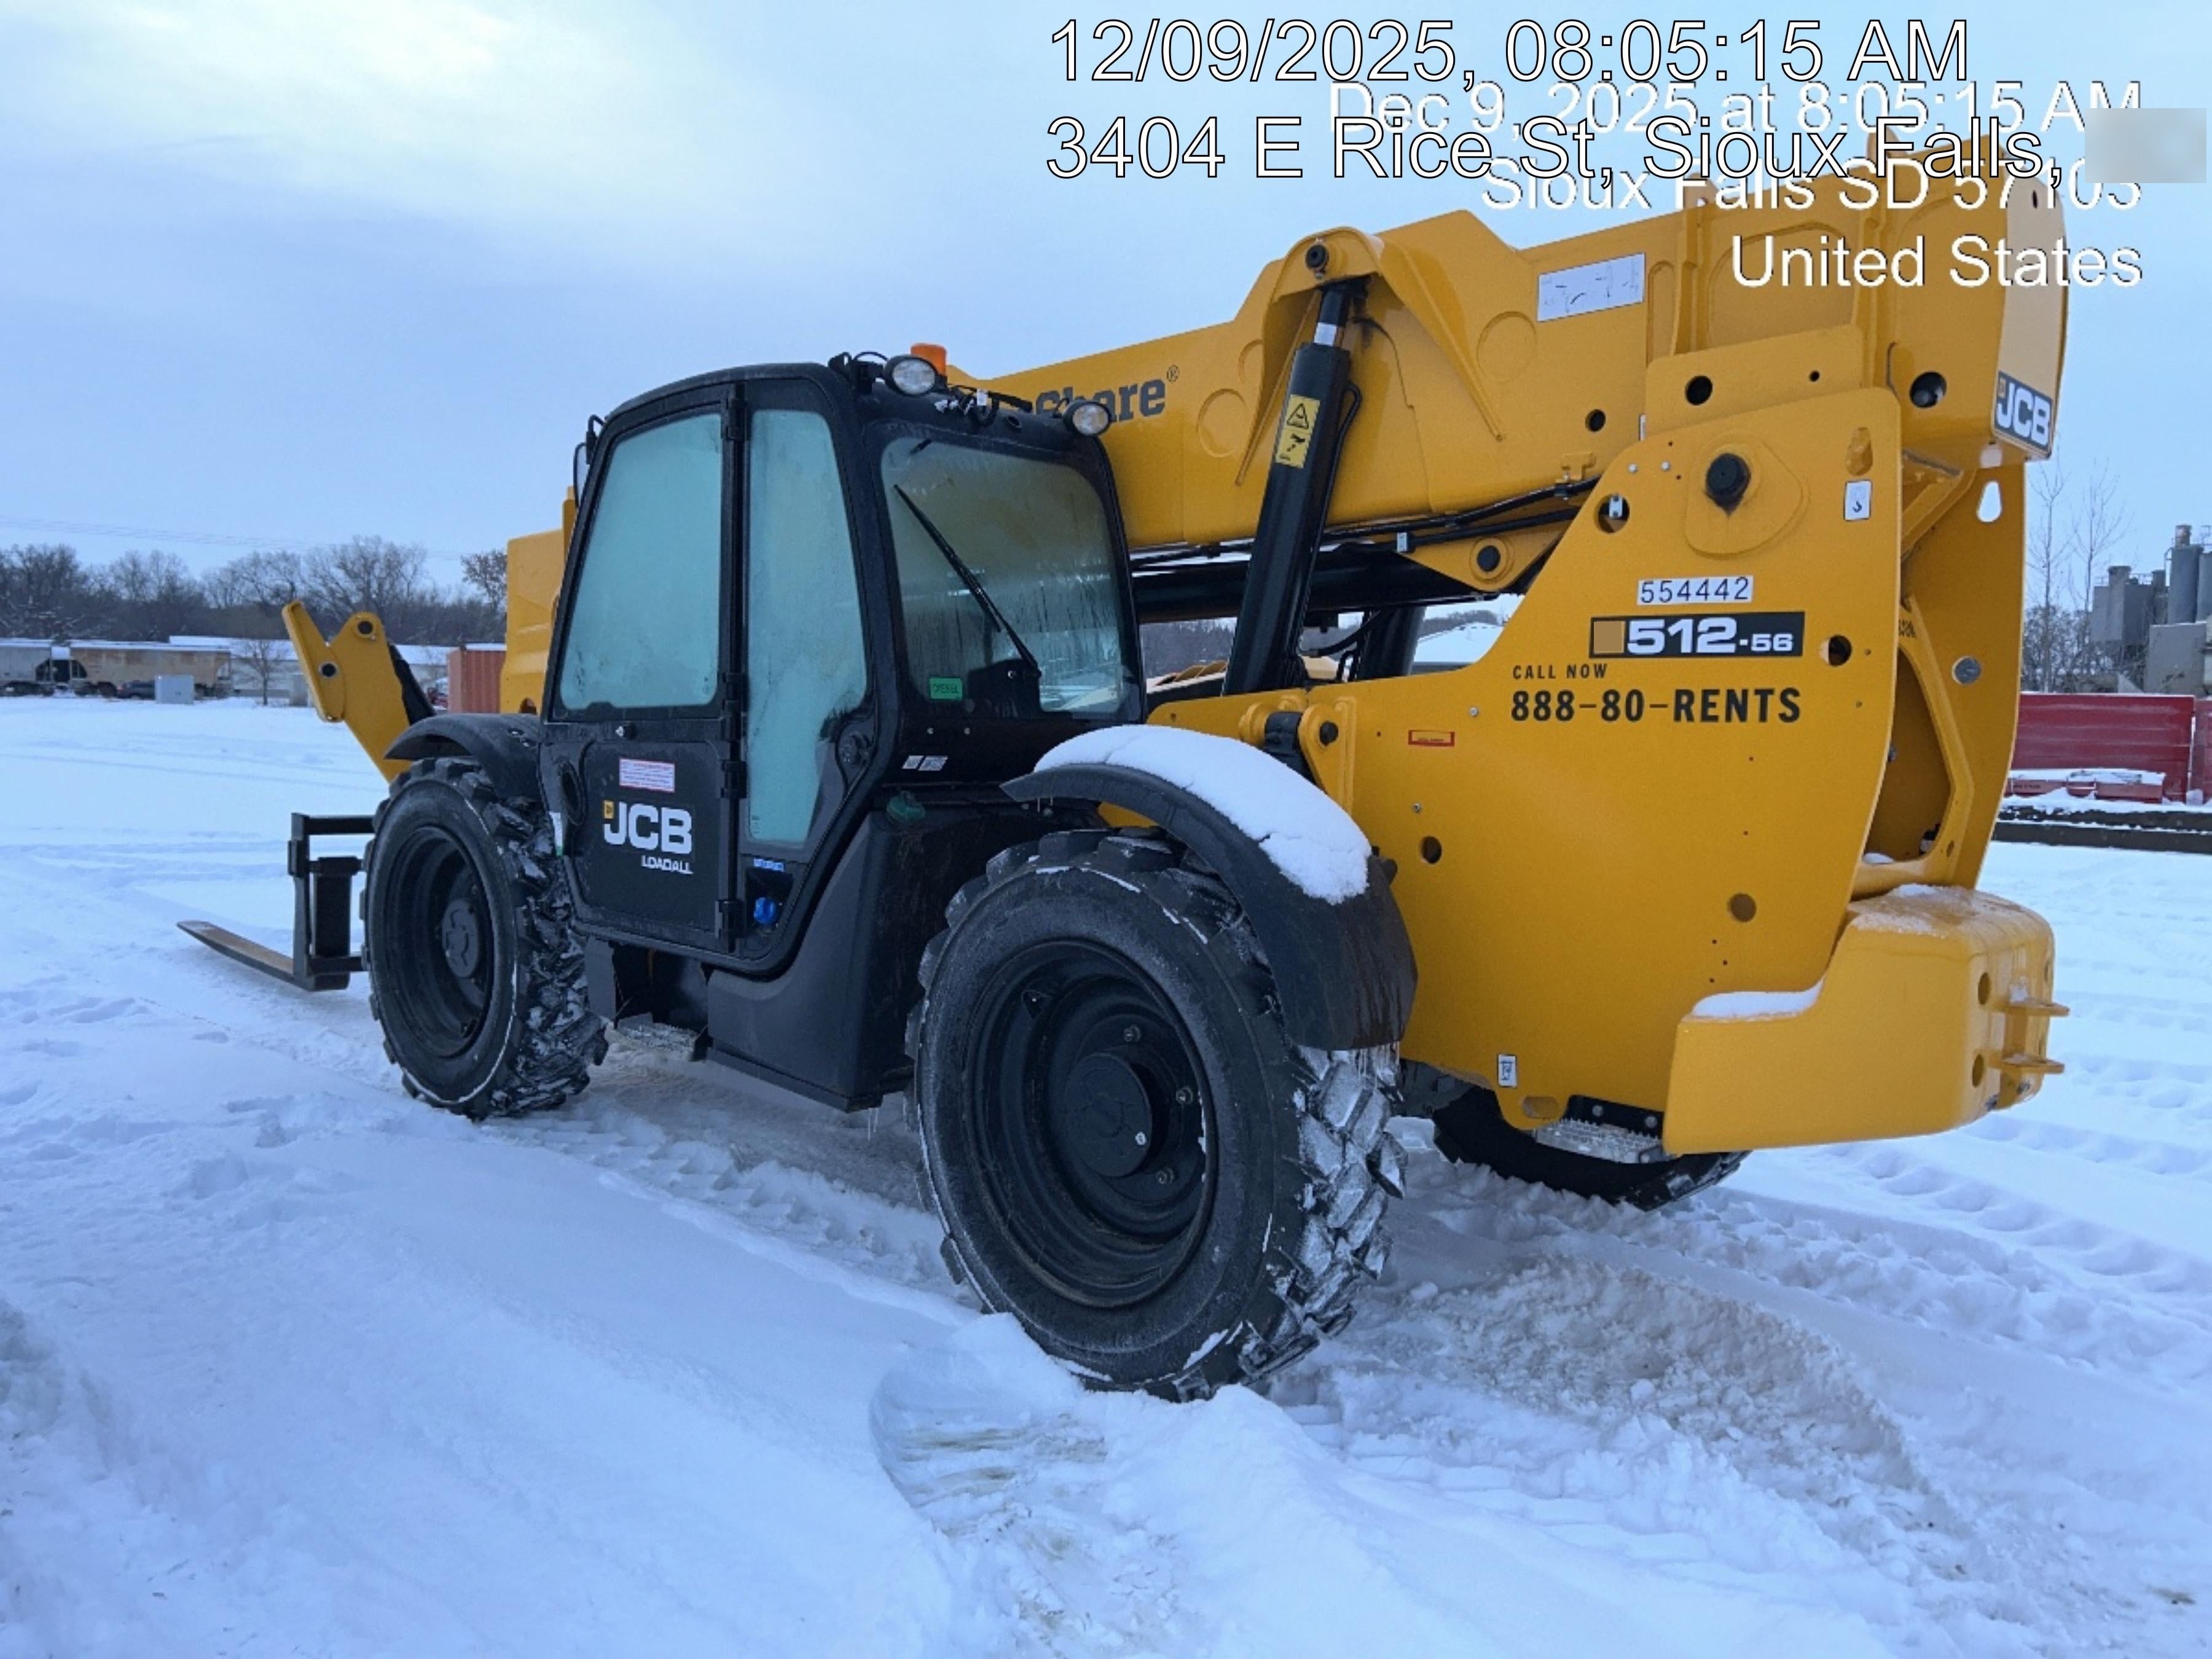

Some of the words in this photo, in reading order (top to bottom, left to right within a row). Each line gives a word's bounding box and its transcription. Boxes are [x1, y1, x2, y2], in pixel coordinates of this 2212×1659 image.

[1996, 382, 2050, 447] JCB
[1640, 576, 1749, 603] 554442
[1512, 665, 1557, 680] CALL
[1566, 663, 1609, 679] NOW
[1511, 687, 1802, 723] 888-80-RENTS
[603, 801, 692, 855] JCB
[641, 855, 694, 874] LOADALL
